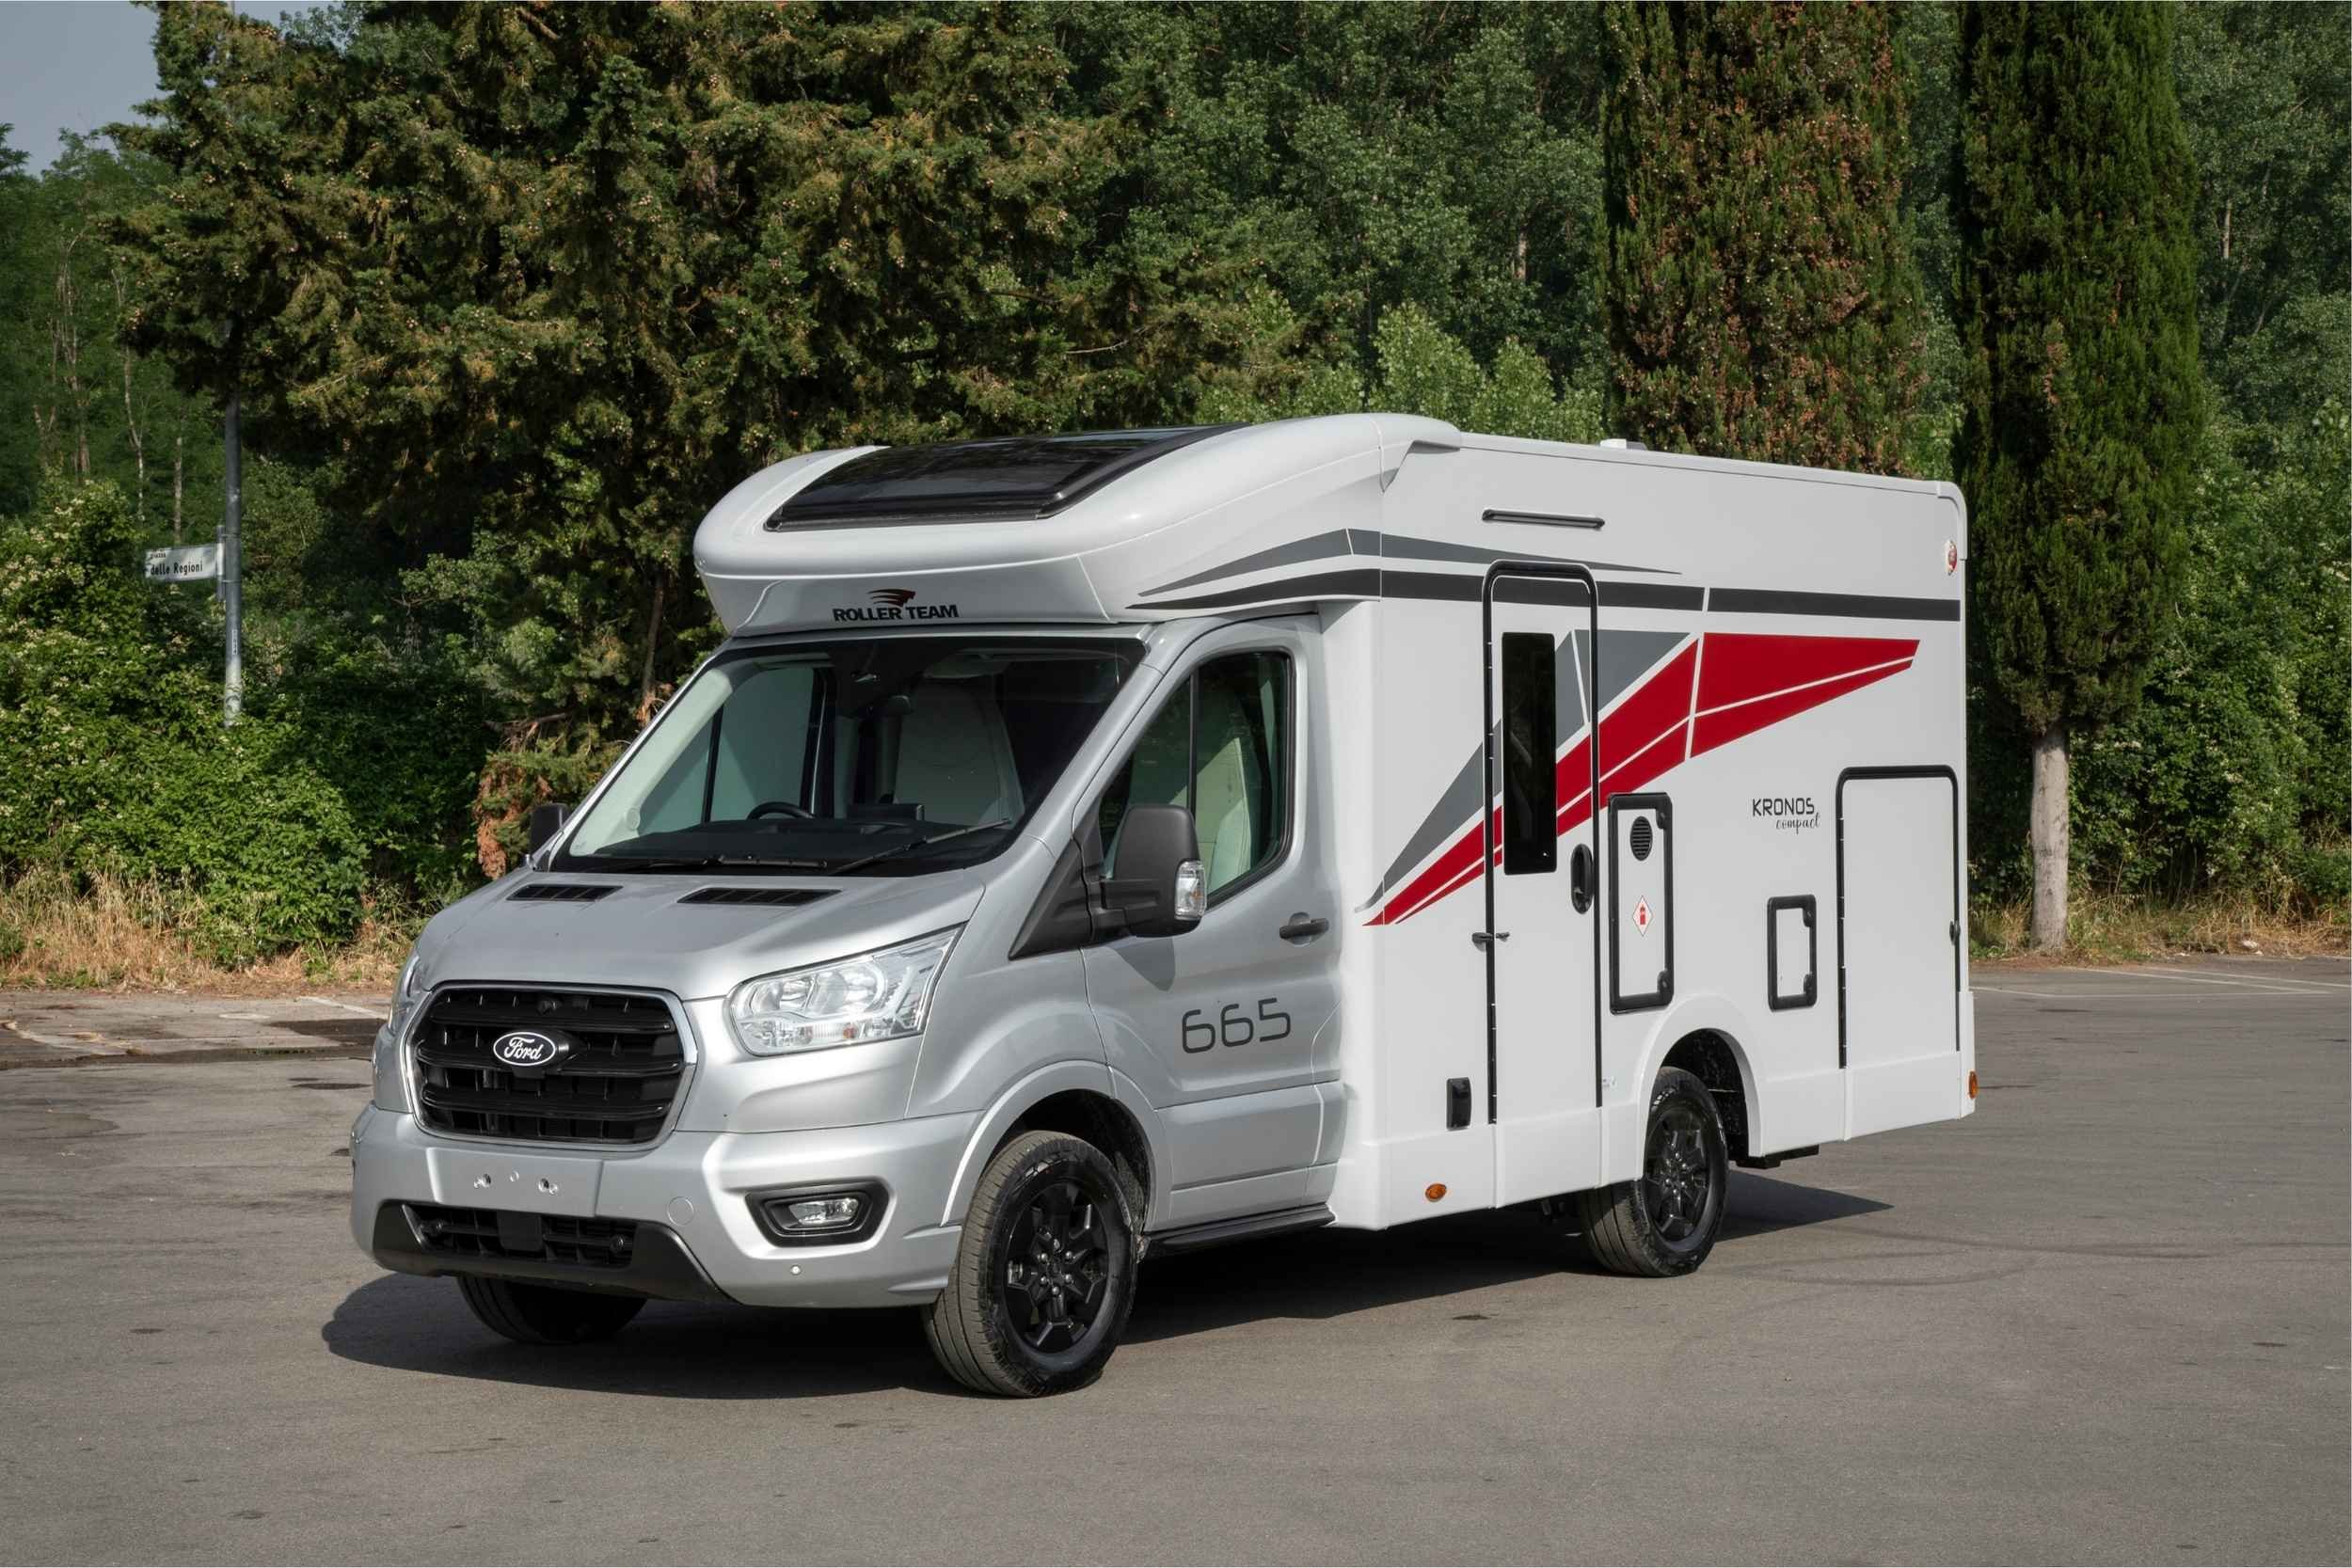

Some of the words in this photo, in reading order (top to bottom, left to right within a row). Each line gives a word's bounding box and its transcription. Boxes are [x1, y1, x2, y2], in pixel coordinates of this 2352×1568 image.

[151, 563, 170, 576] delle
[173, 560, 203, 576] Regioni
[832, 607, 903, 622] ROLLER
[905, 604, 960, 620] TEAM
[1752, 797, 1815, 816] KRONOS
[1775, 812, 1820, 835] compact
[1182, 997, 1292, 1054] 665
[503, 1037, 545, 1060] Ford
